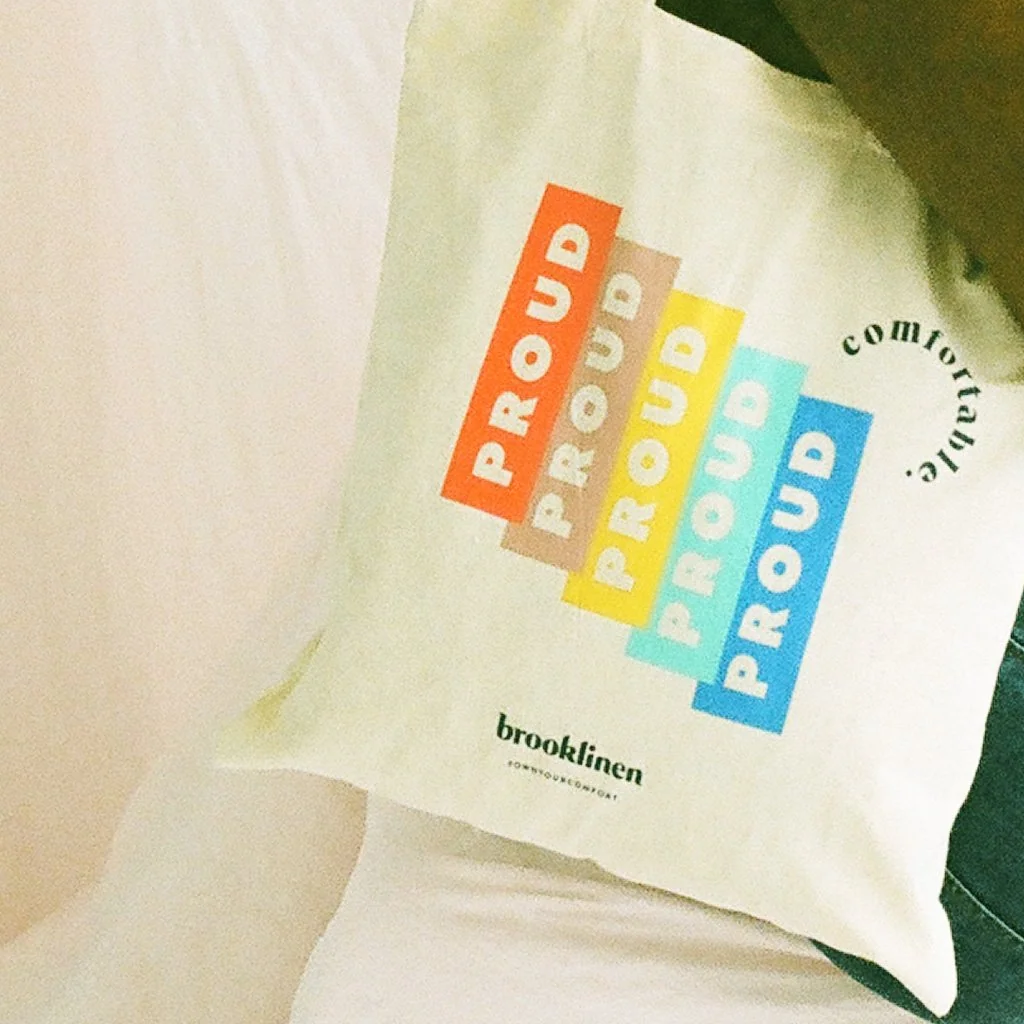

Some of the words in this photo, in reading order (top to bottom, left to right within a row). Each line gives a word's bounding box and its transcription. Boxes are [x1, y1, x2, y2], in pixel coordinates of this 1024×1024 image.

[472, 223, 590, 487] PROUD
[532, 272, 643, 539] PROUD
[593, 325, 706, 593] PROUD
[842, 320, 982, 483] comfortable.
[657, 380, 771, 648] PROUD
[723, 430, 837, 700] PROUD
[496, 711, 643, 786] brooklinen
